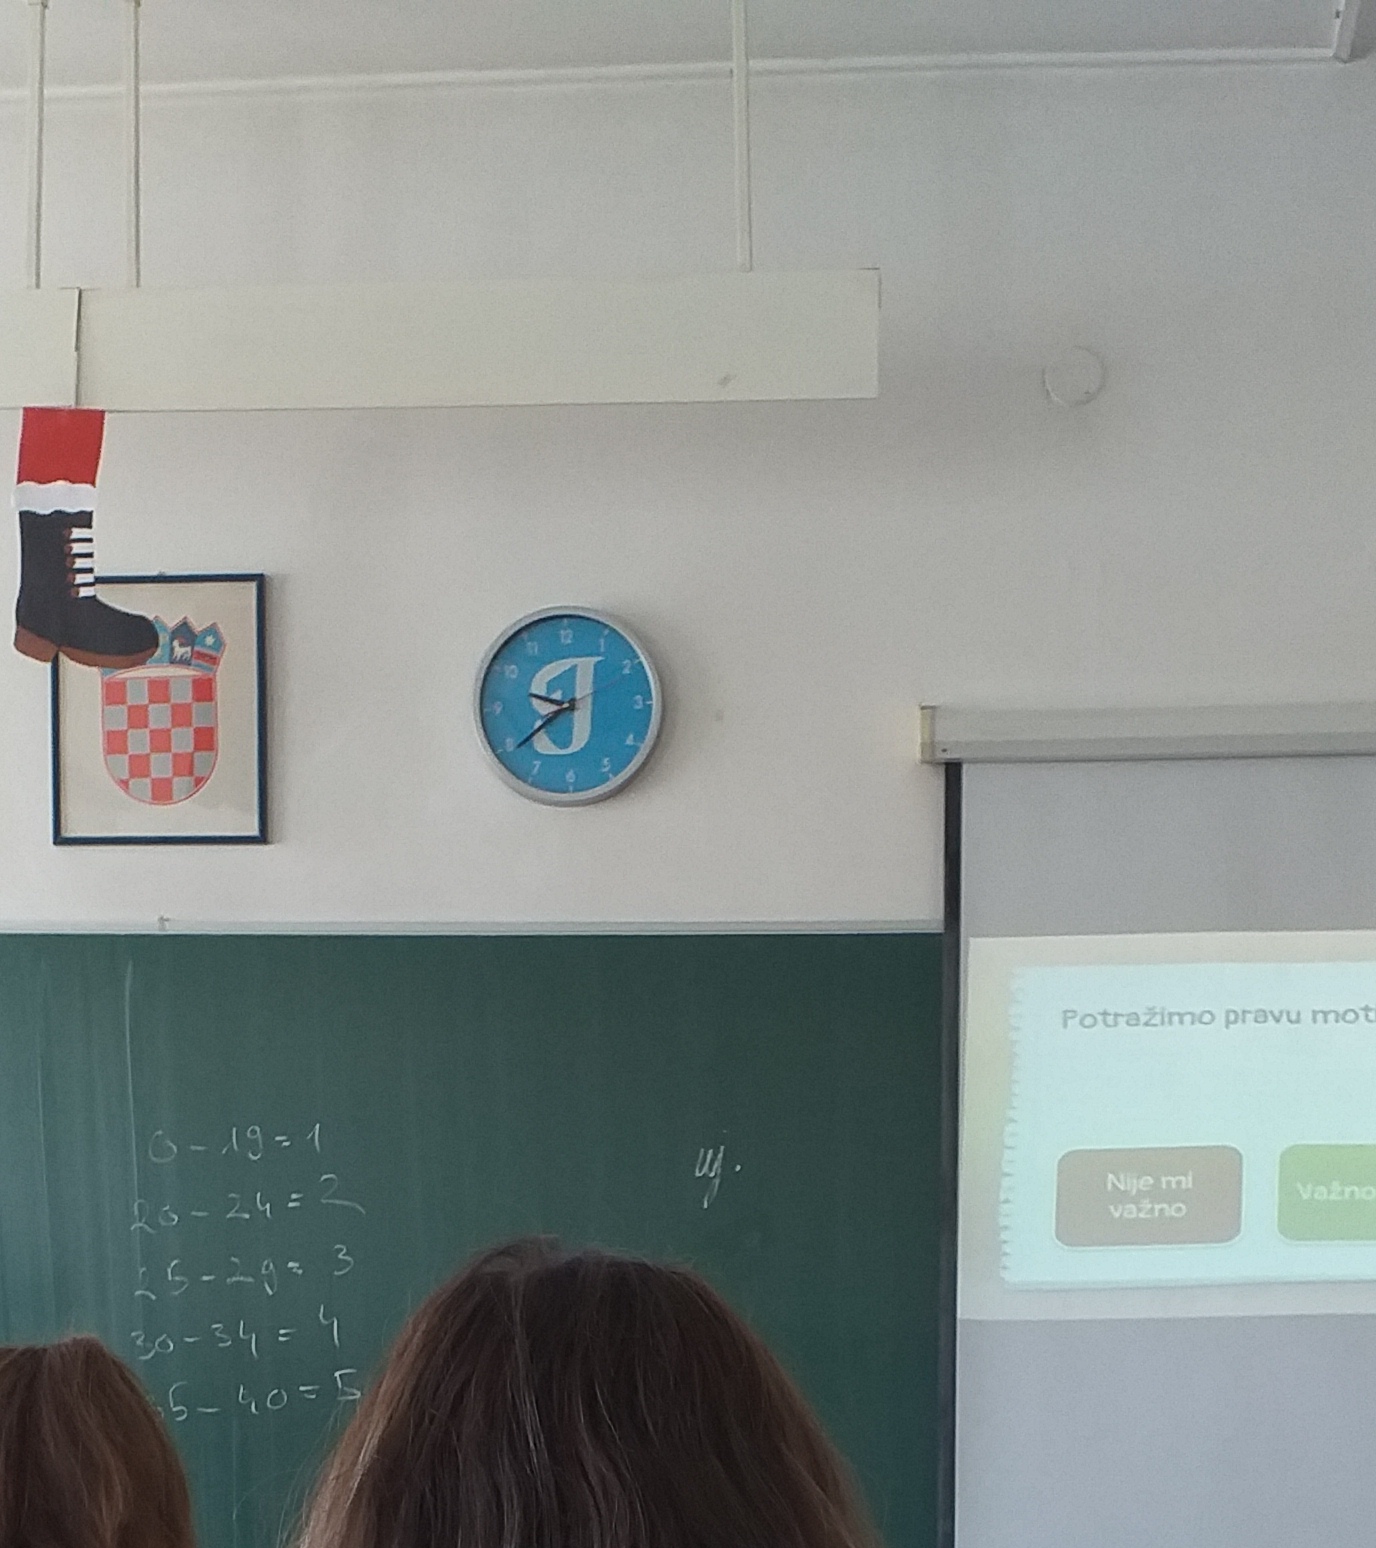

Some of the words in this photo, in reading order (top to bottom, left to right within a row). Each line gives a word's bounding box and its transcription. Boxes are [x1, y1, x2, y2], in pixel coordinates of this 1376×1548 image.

[622, 659, 632, 674] 2
[633, 695, 643, 709] 3
[532, 760, 542, 775] 7
[602, 757, 611, 772] 5
[1061, 1006, 1216, 1030] Potražimo
[1224, 1008, 1302, 1029] pravu
[1107, 1173, 1154, 1195] Nije
[1160, 1170, 1193, 1191] mi
[1297, 1181, 1376, 1201] Važno
[1109, 1198, 1187, 1219] važno
